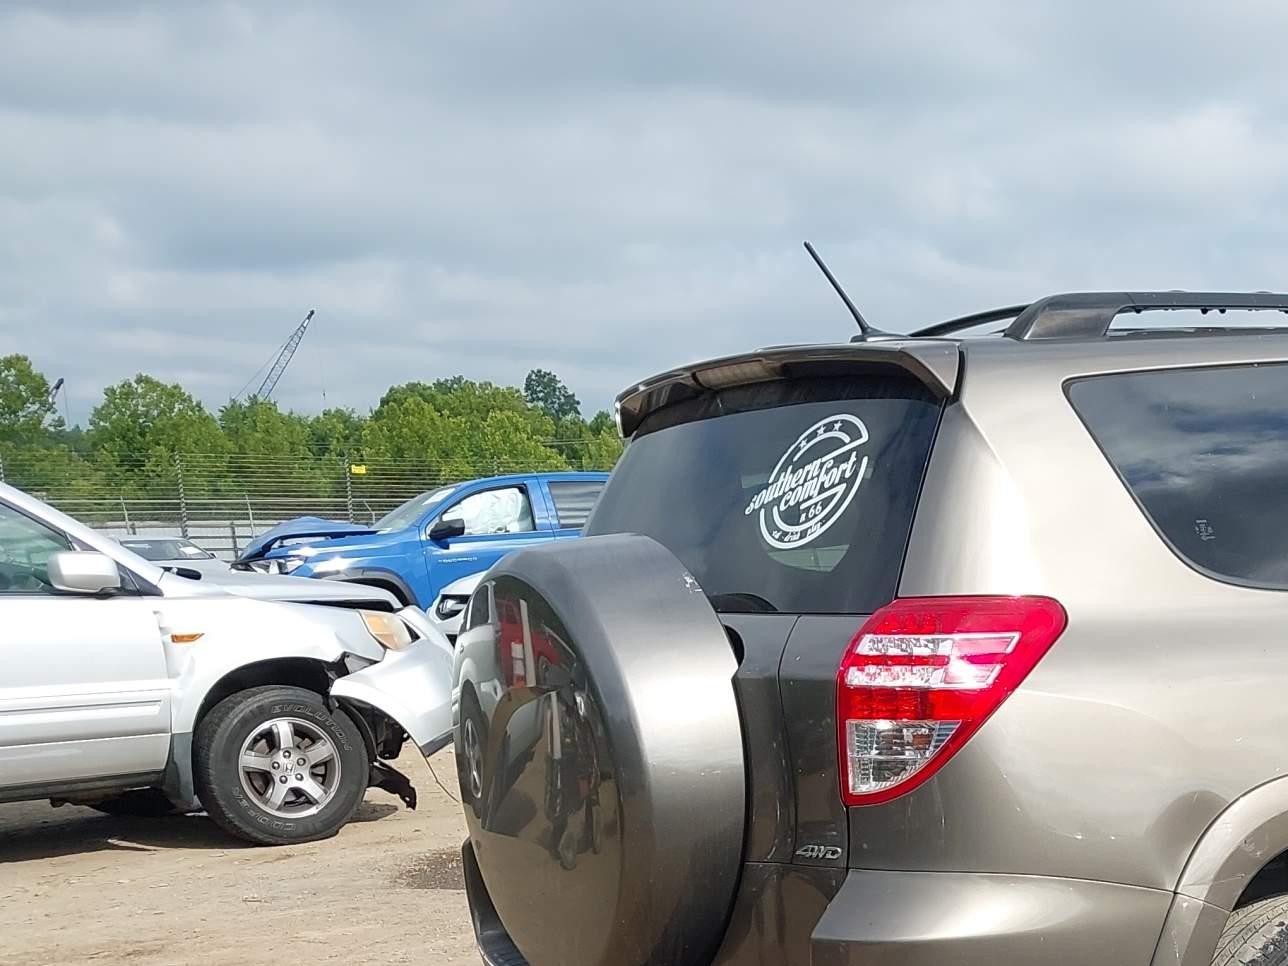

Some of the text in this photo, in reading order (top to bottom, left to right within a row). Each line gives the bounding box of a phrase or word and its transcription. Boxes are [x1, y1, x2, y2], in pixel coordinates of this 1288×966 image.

[808, 501, 823, 518] 66
[272, 704, 352, 751] EVOLUTION
[795, 844, 842, 859] 4WD
